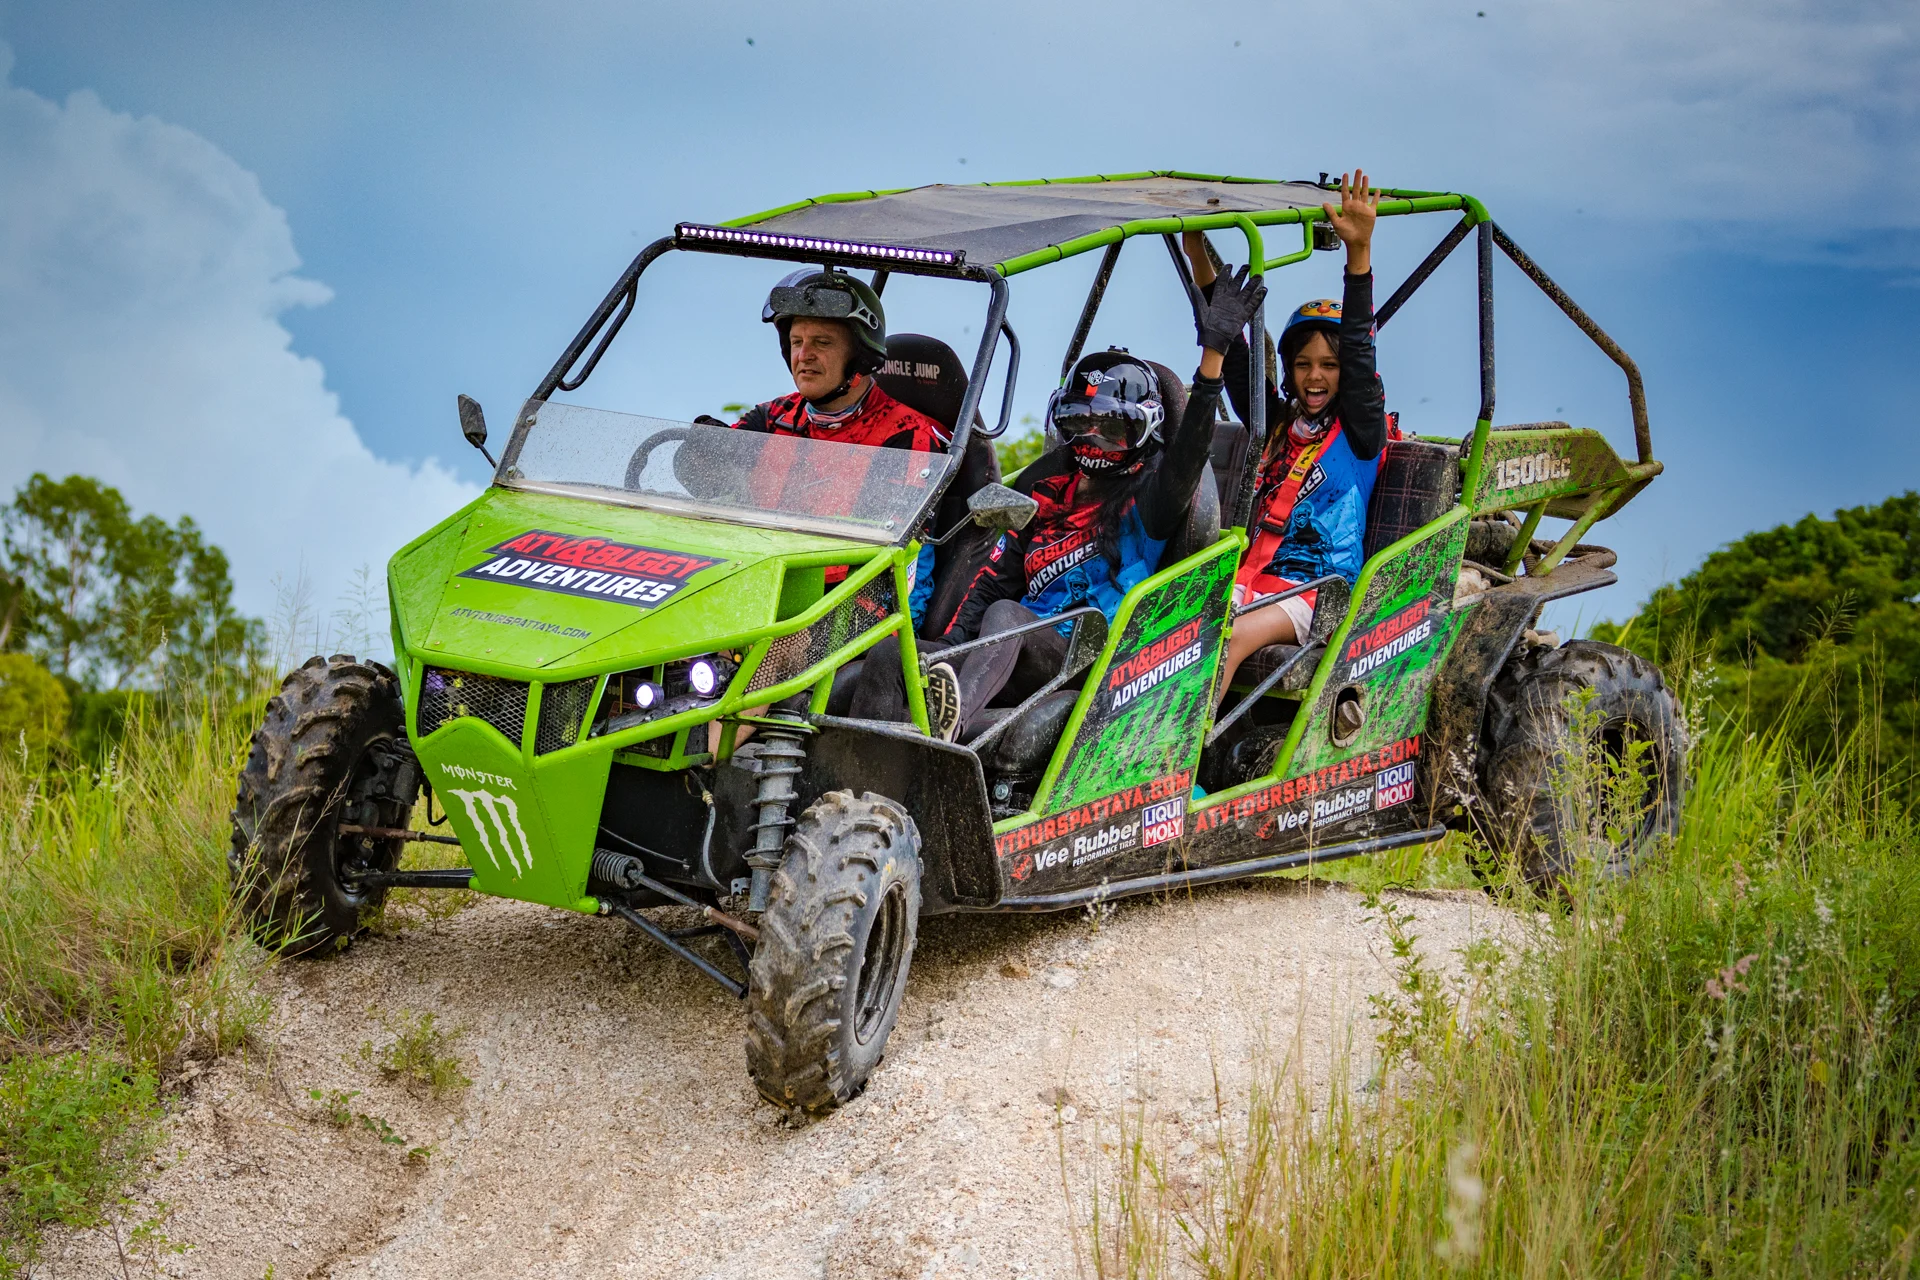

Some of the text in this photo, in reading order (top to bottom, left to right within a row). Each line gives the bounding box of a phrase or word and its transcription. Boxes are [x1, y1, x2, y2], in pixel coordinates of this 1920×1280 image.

[877, 360, 940, 379] UNGLE JUMP
[498, 532, 713, 579] ATV&BUGGY
[475, 557, 677, 602] ADVENTURES
[450, 607, 592, 640] ATVTOURSPATTAYA.COM
[1346, 596, 1433, 662] ATV&BUGGY
[1108, 617, 1203, 691] ATV&BUGGY
[1349, 620, 1431, 681] ADVENTURES
[1112, 642, 1202, 711] ADVENTURES
[1196, 735, 1419, 834] ATVTOURSPATTAYA.COM
[1378, 764, 1412, 790] LIQUI
[1378, 782, 1412, 808] MOLY
[1144, 801, 1181, 827] LIQUI
[1277, 810, 1309, 832] Vee
[1313, 786, 1374, 819] Rubber
[1034, 846, 1069, 871] Vee
[1073, 820, 1141, 857] Rubber
[1072, 838, 1137, 867] PERFORMANCE TIRES
[1145, 822, 1182, 845] MOLY
